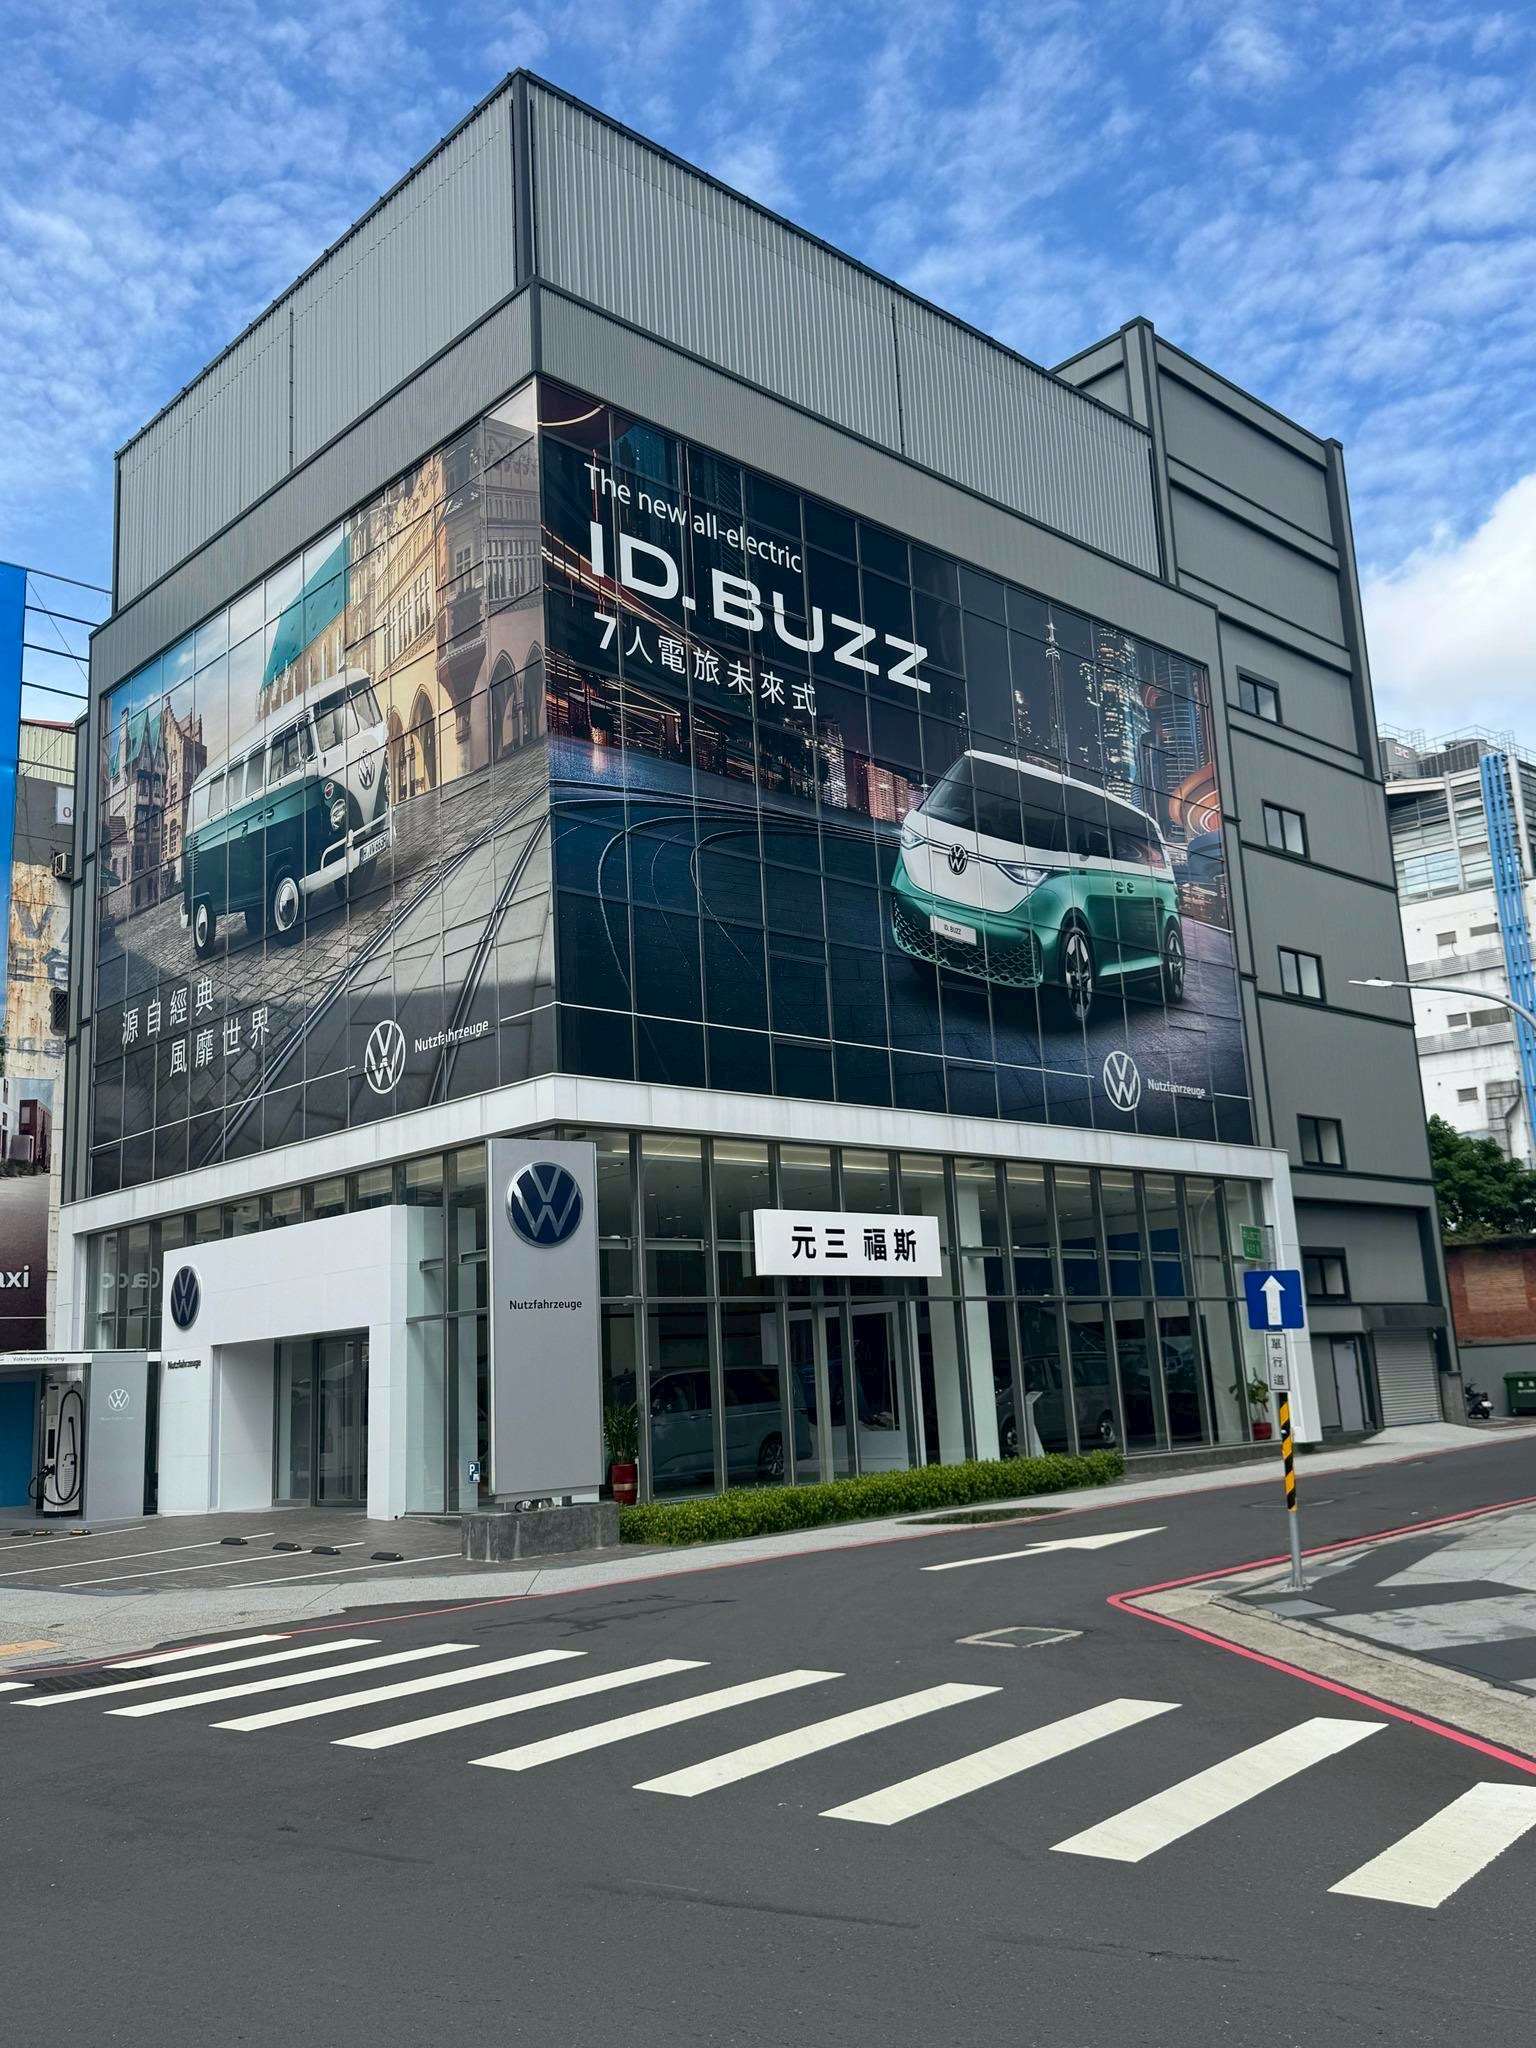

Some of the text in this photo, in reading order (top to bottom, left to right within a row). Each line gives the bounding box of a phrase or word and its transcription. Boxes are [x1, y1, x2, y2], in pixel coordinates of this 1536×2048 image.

[584, 462, 802, 573] The new all-electric
[594, 612, 817, 717] 7人電旅未來式
[122, 976, 214, 1045] 源自經典
[169, 1006, 270, 1077] 風靡世界
[414, 1020, 489, 1053] Nutzfahrzeuge
[1147, 1078, 1206, 1099] Nutzfahrzeuge
[509, 1300, 582, 1311] Nutzfahrzeuge
[167, 1359, 201, 1370] Nutzfahrzeuge
[1271, 1338, 1285, 1386] 單行道
